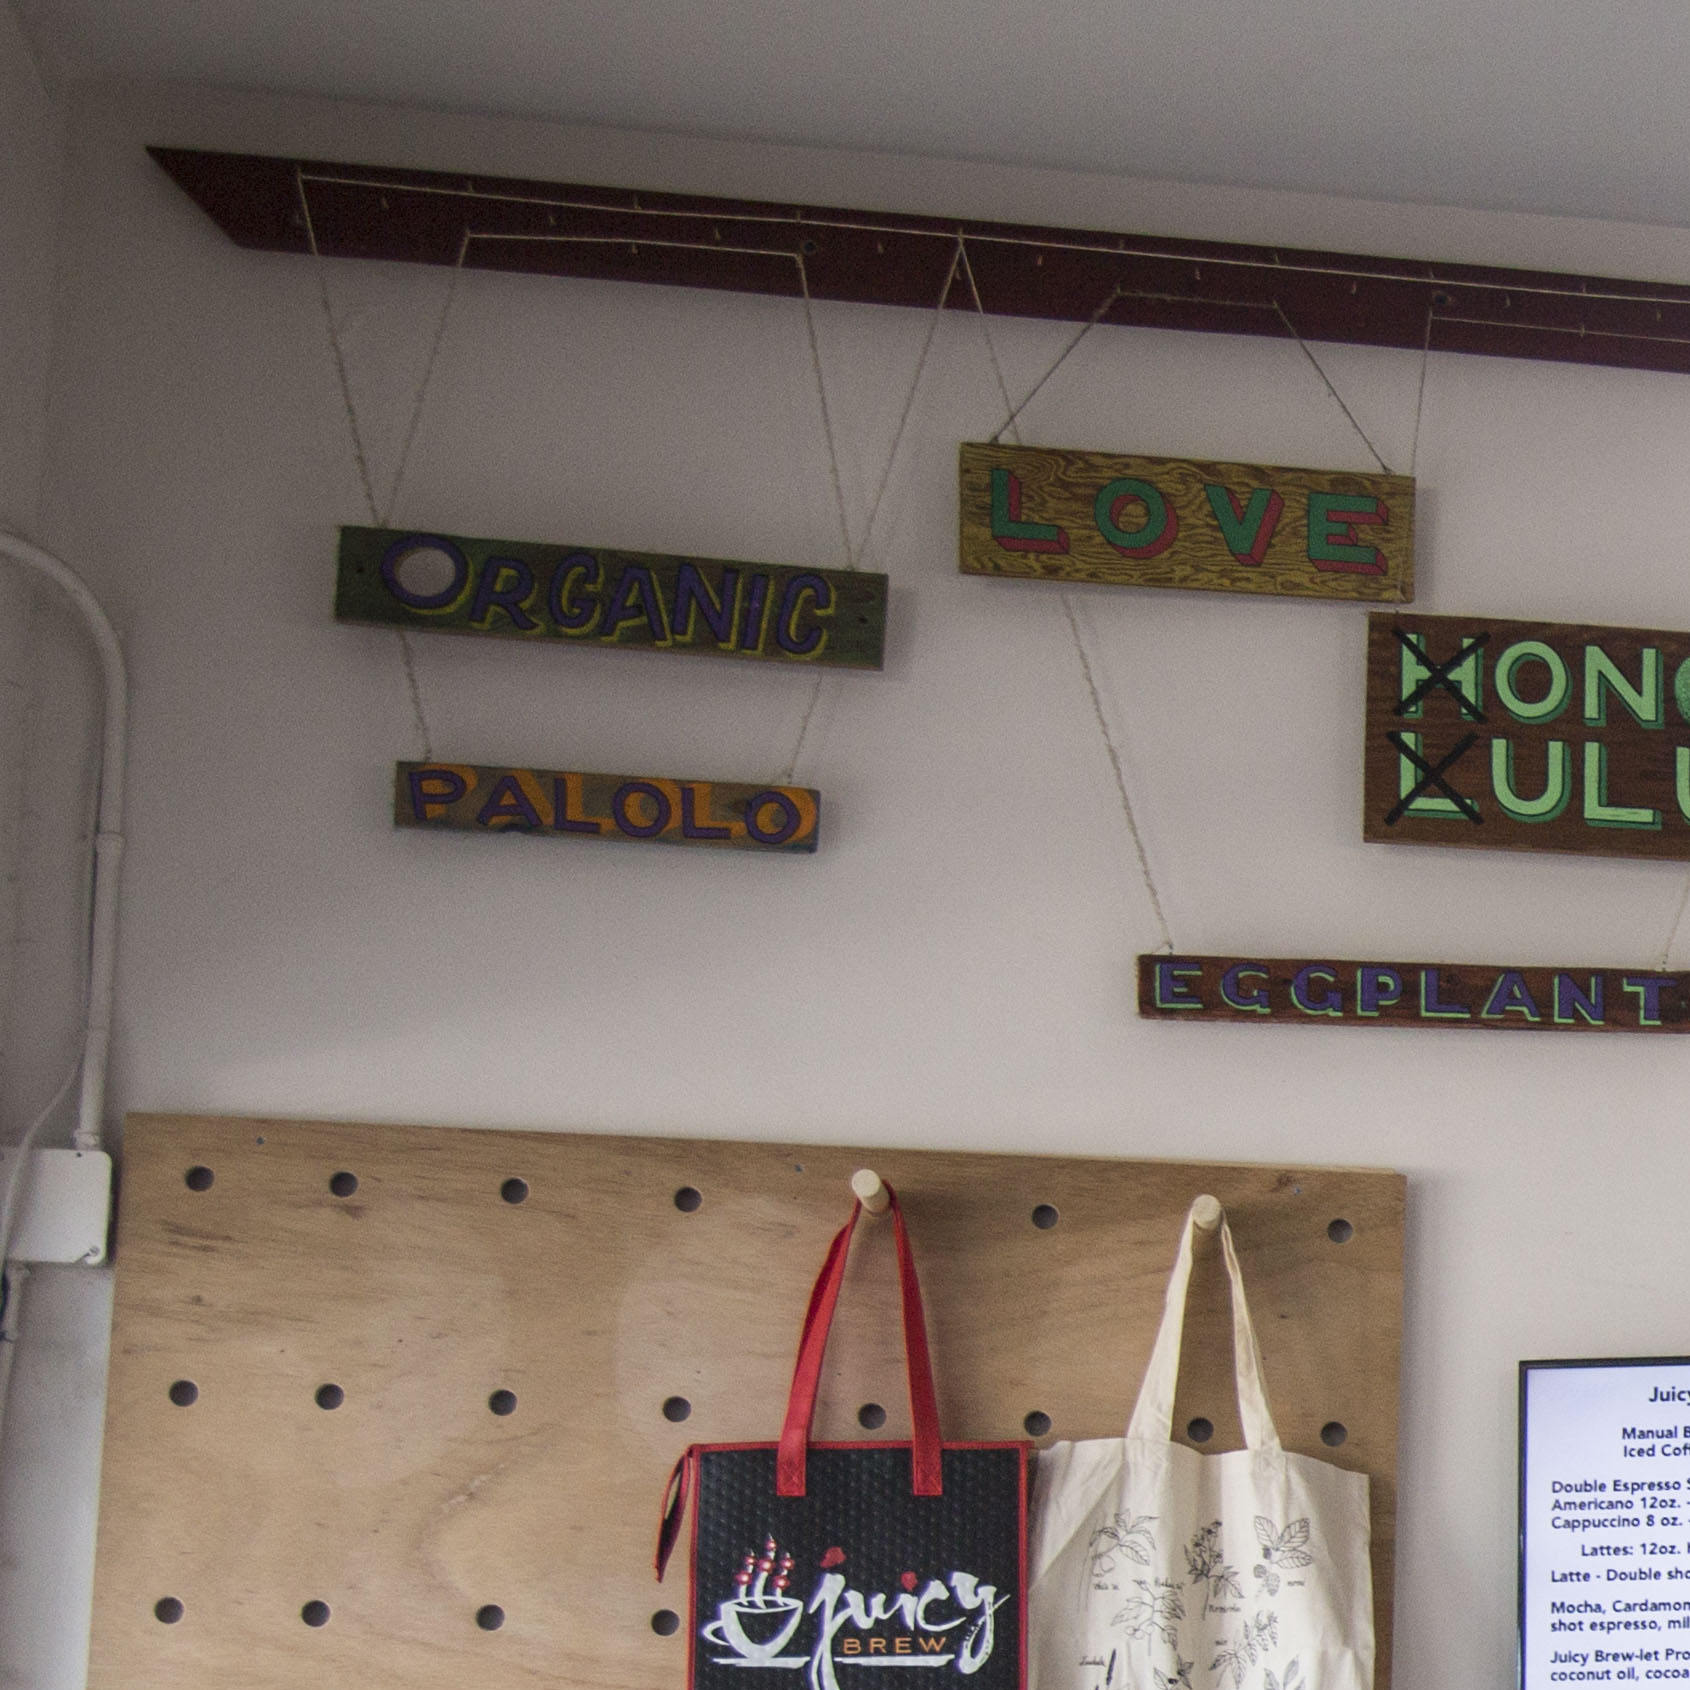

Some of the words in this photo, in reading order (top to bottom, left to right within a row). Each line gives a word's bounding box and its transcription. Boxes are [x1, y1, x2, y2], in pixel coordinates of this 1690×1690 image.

[990, 468, 1389, 576] LOVE
[381, 533, 836, 659] ORGANIC
[408, 762, 816, 847] PALOLO
[1154, 962, 1677, 1026] EGGPLANT
[1551, 1497, 1634, 1512] Americano
[1640, 1495, 1681, 1510] 12oz.
[1552, 1479, 1607, 1494] Double
[1613, 1479, 1681, 1495] Espresso
[842, 1637, 947, 1655] BREW
